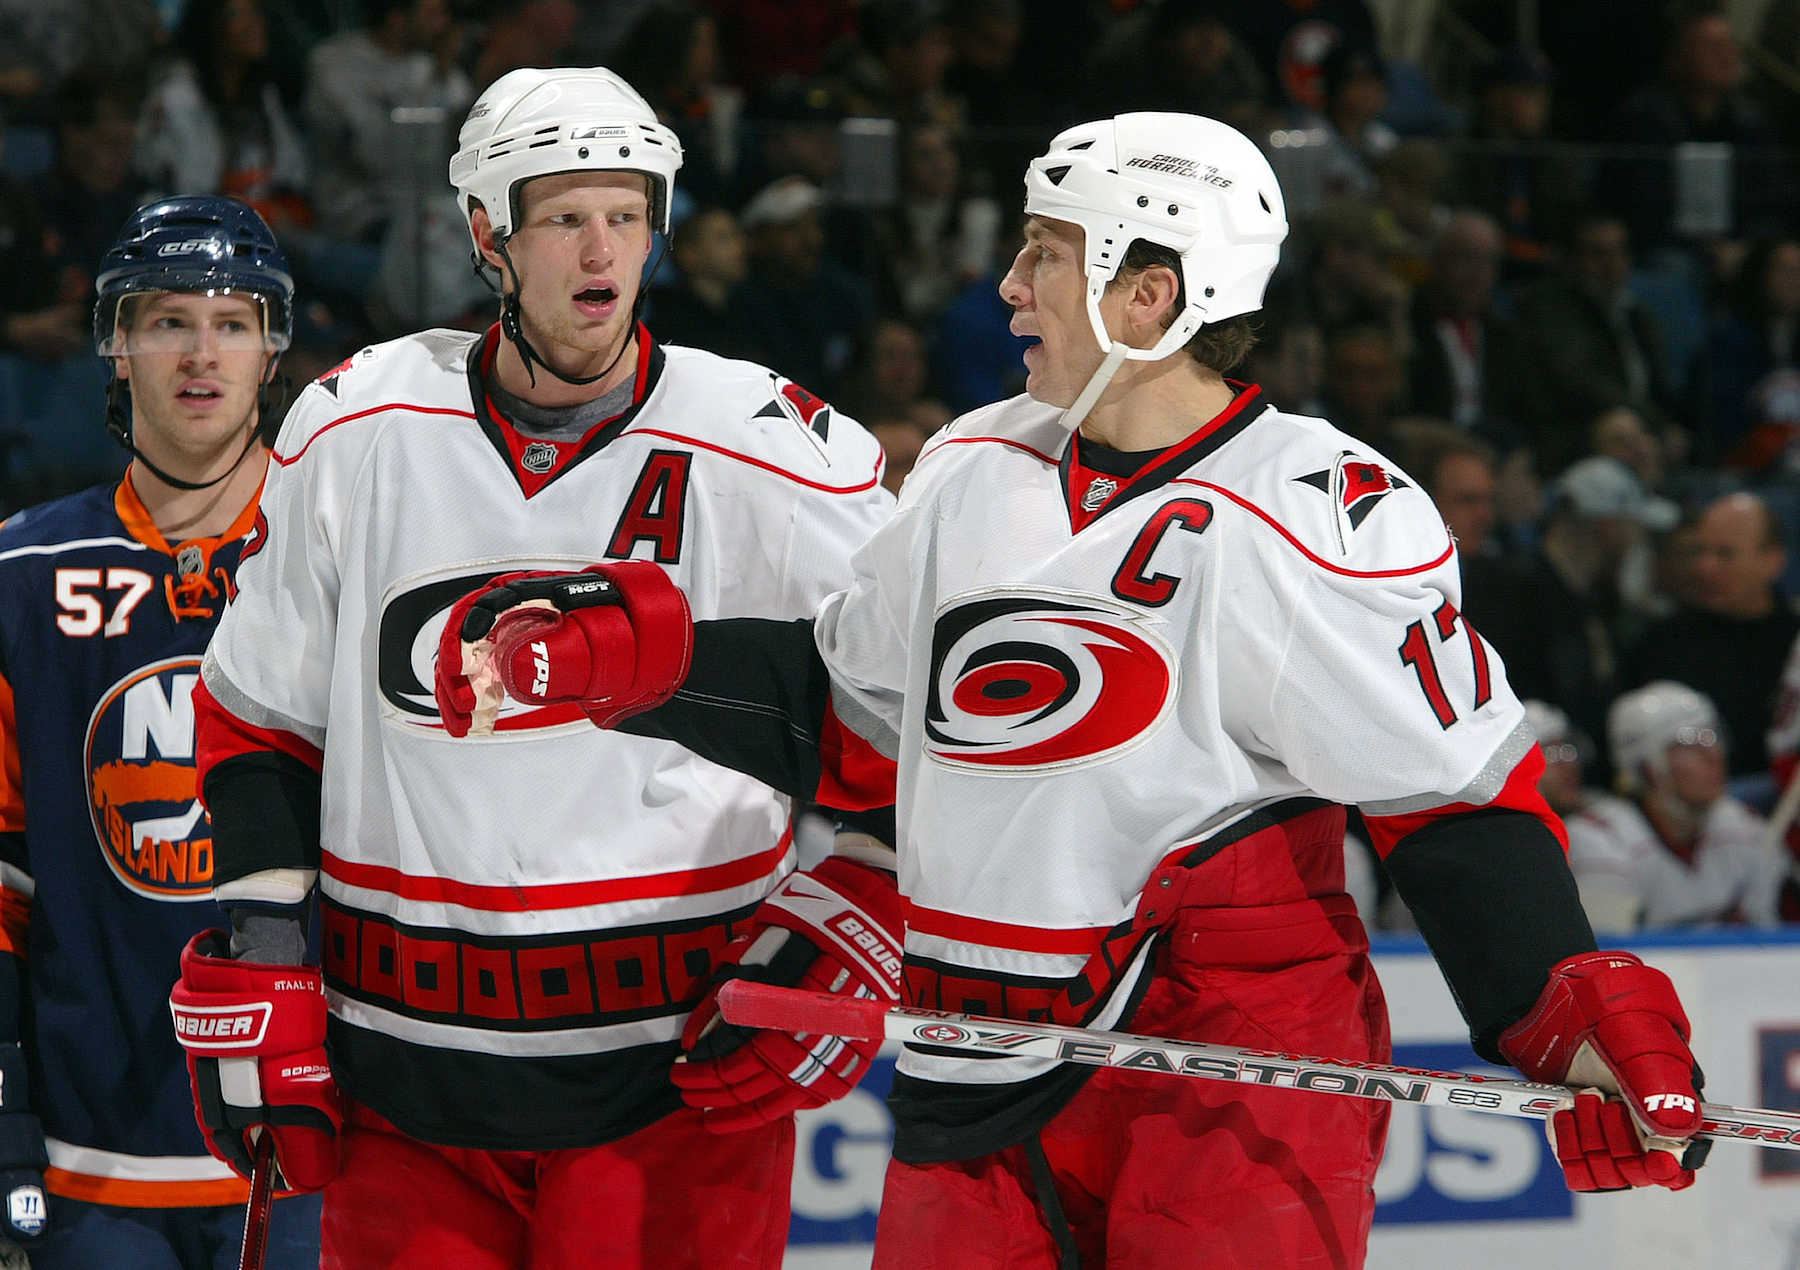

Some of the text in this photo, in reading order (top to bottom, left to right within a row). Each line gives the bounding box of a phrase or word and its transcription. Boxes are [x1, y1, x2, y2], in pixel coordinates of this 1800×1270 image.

[603, 448, 693, 564] A
[1111, 497, 1213, 608] C
[55, 567, 153, 639] 57
[531, 641, 550, 696] TPS
[1398, 598, 1492, 731] 17
[104, 803, 214, 884] ISLAND
[176, 1014, 253, 1037] BAUER
[1056, 1038, 1430, 1104] EASTON
[1643, 1093, 1696, 1113] TPS
